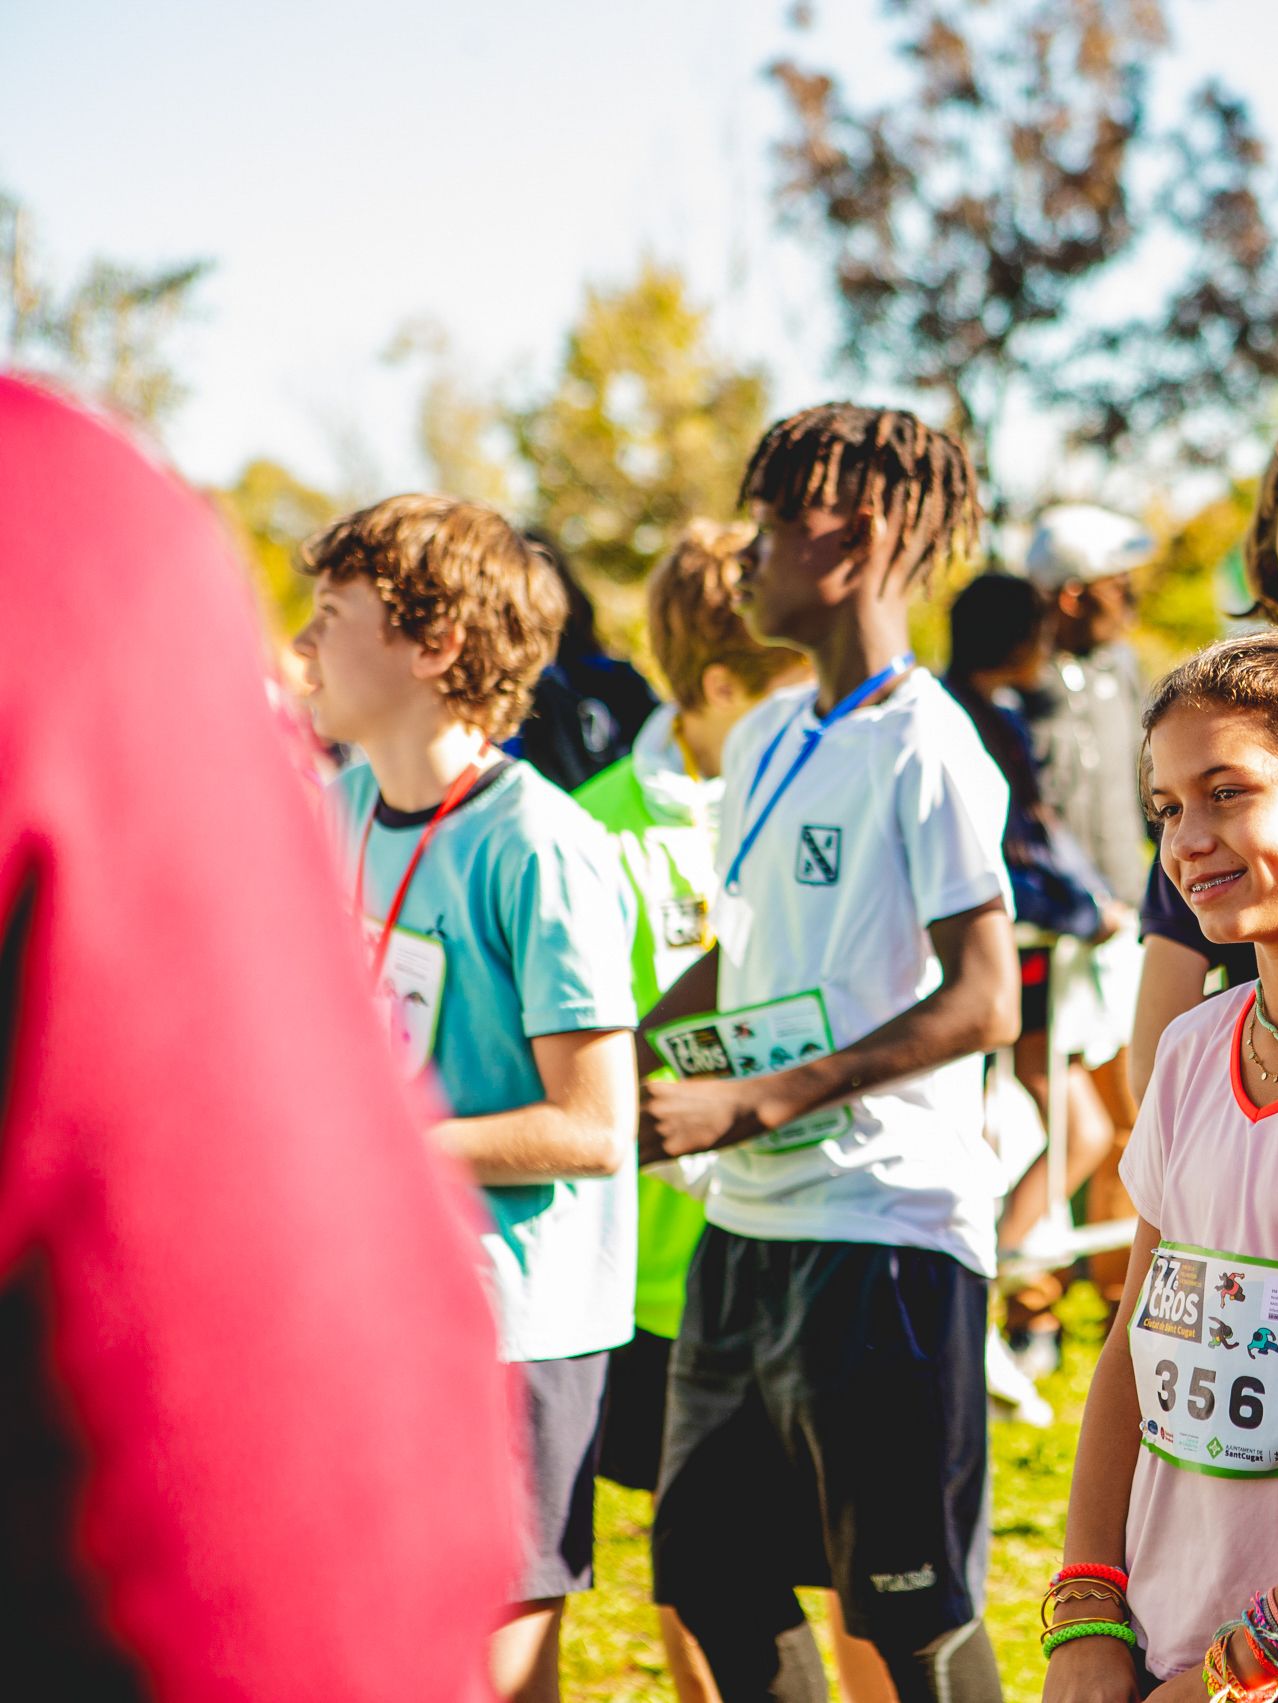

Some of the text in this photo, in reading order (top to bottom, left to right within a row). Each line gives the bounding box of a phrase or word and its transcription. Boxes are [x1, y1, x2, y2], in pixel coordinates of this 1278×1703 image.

[1149, 1286, 1200, 1325] CROS
[1177, 1326, 1196, 1339] Cugat
[1155, 1359, 1265, 1430] 356
[1225, 1444, 1256, 1455] AJUNTAMENT
[1225, 1450, 1264, 1462] SantCugat
